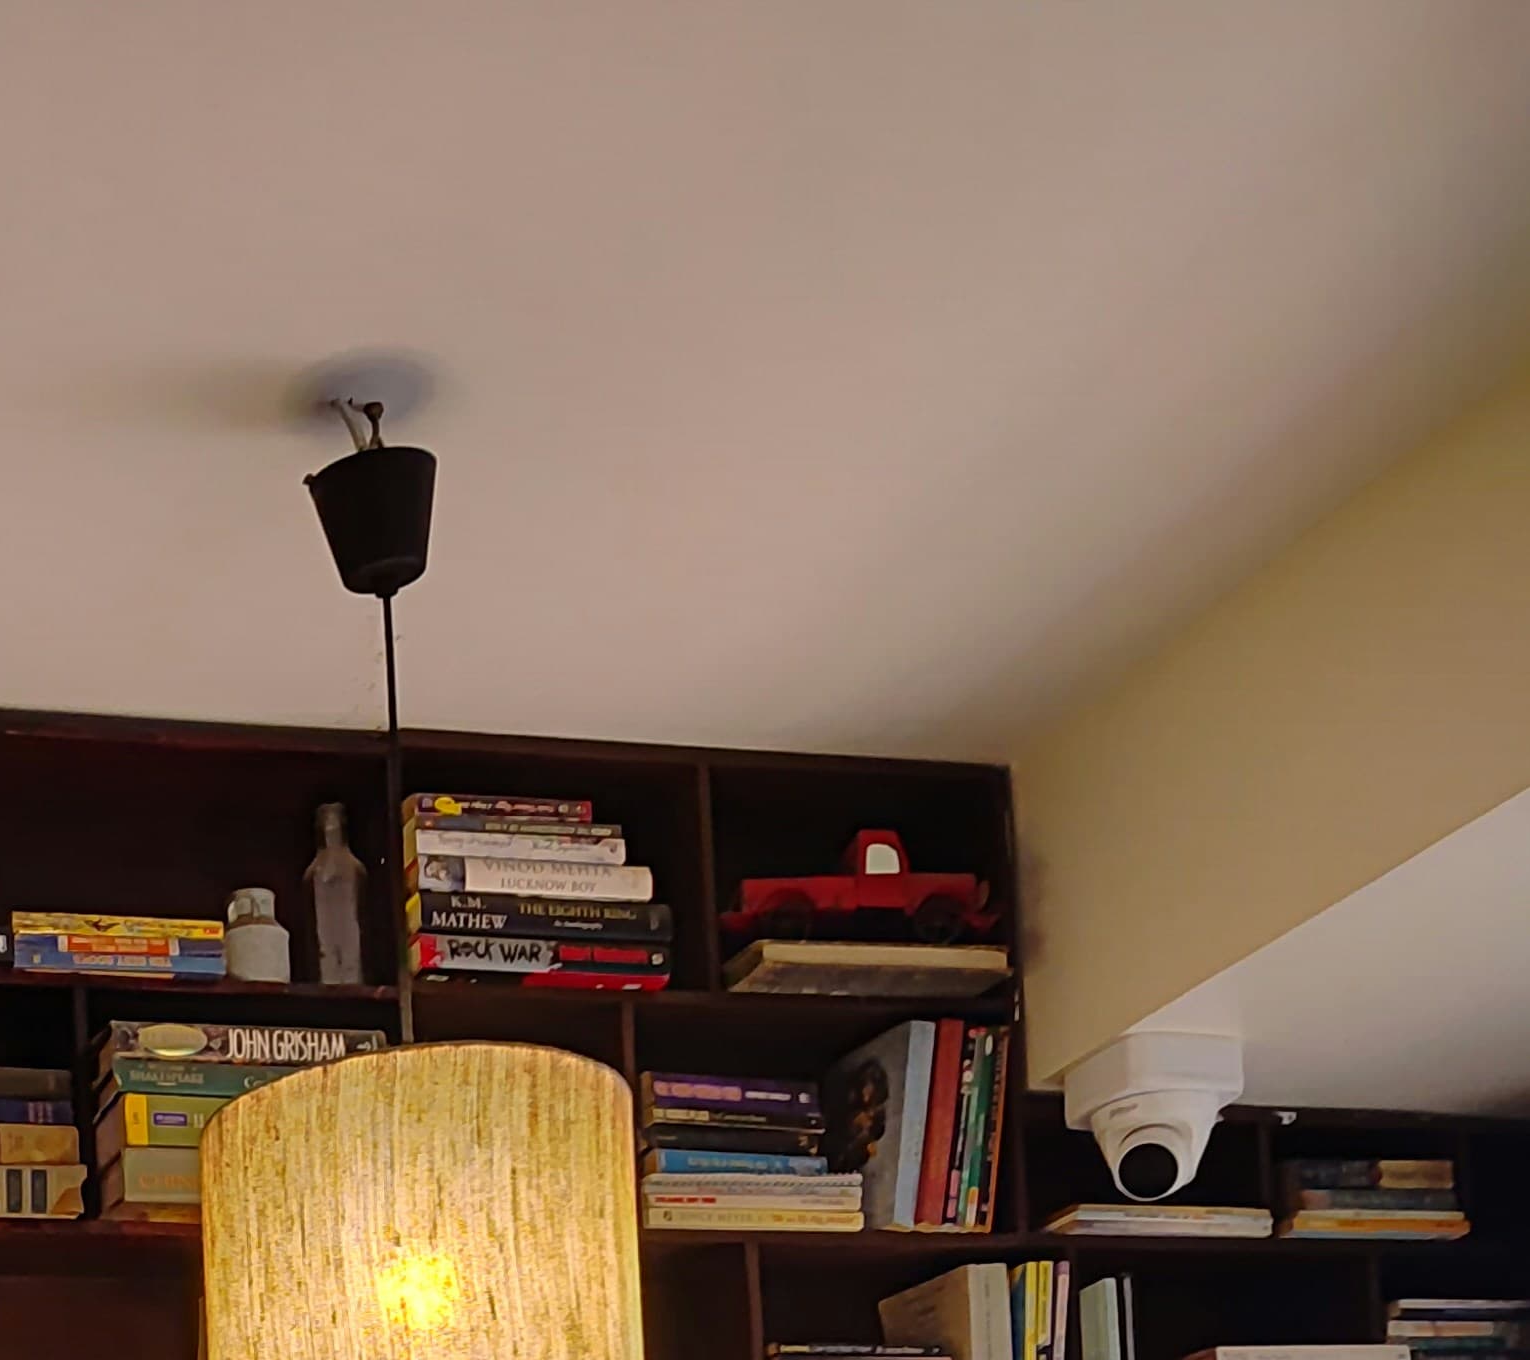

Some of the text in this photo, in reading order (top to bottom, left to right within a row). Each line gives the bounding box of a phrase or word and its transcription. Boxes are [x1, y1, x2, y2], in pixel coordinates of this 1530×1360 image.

[431, 910, 508, 929] MATHEW
[499, 943, 540, 962] WAR
[227, 1027, 347, 1061] JOHN GRISHAM
